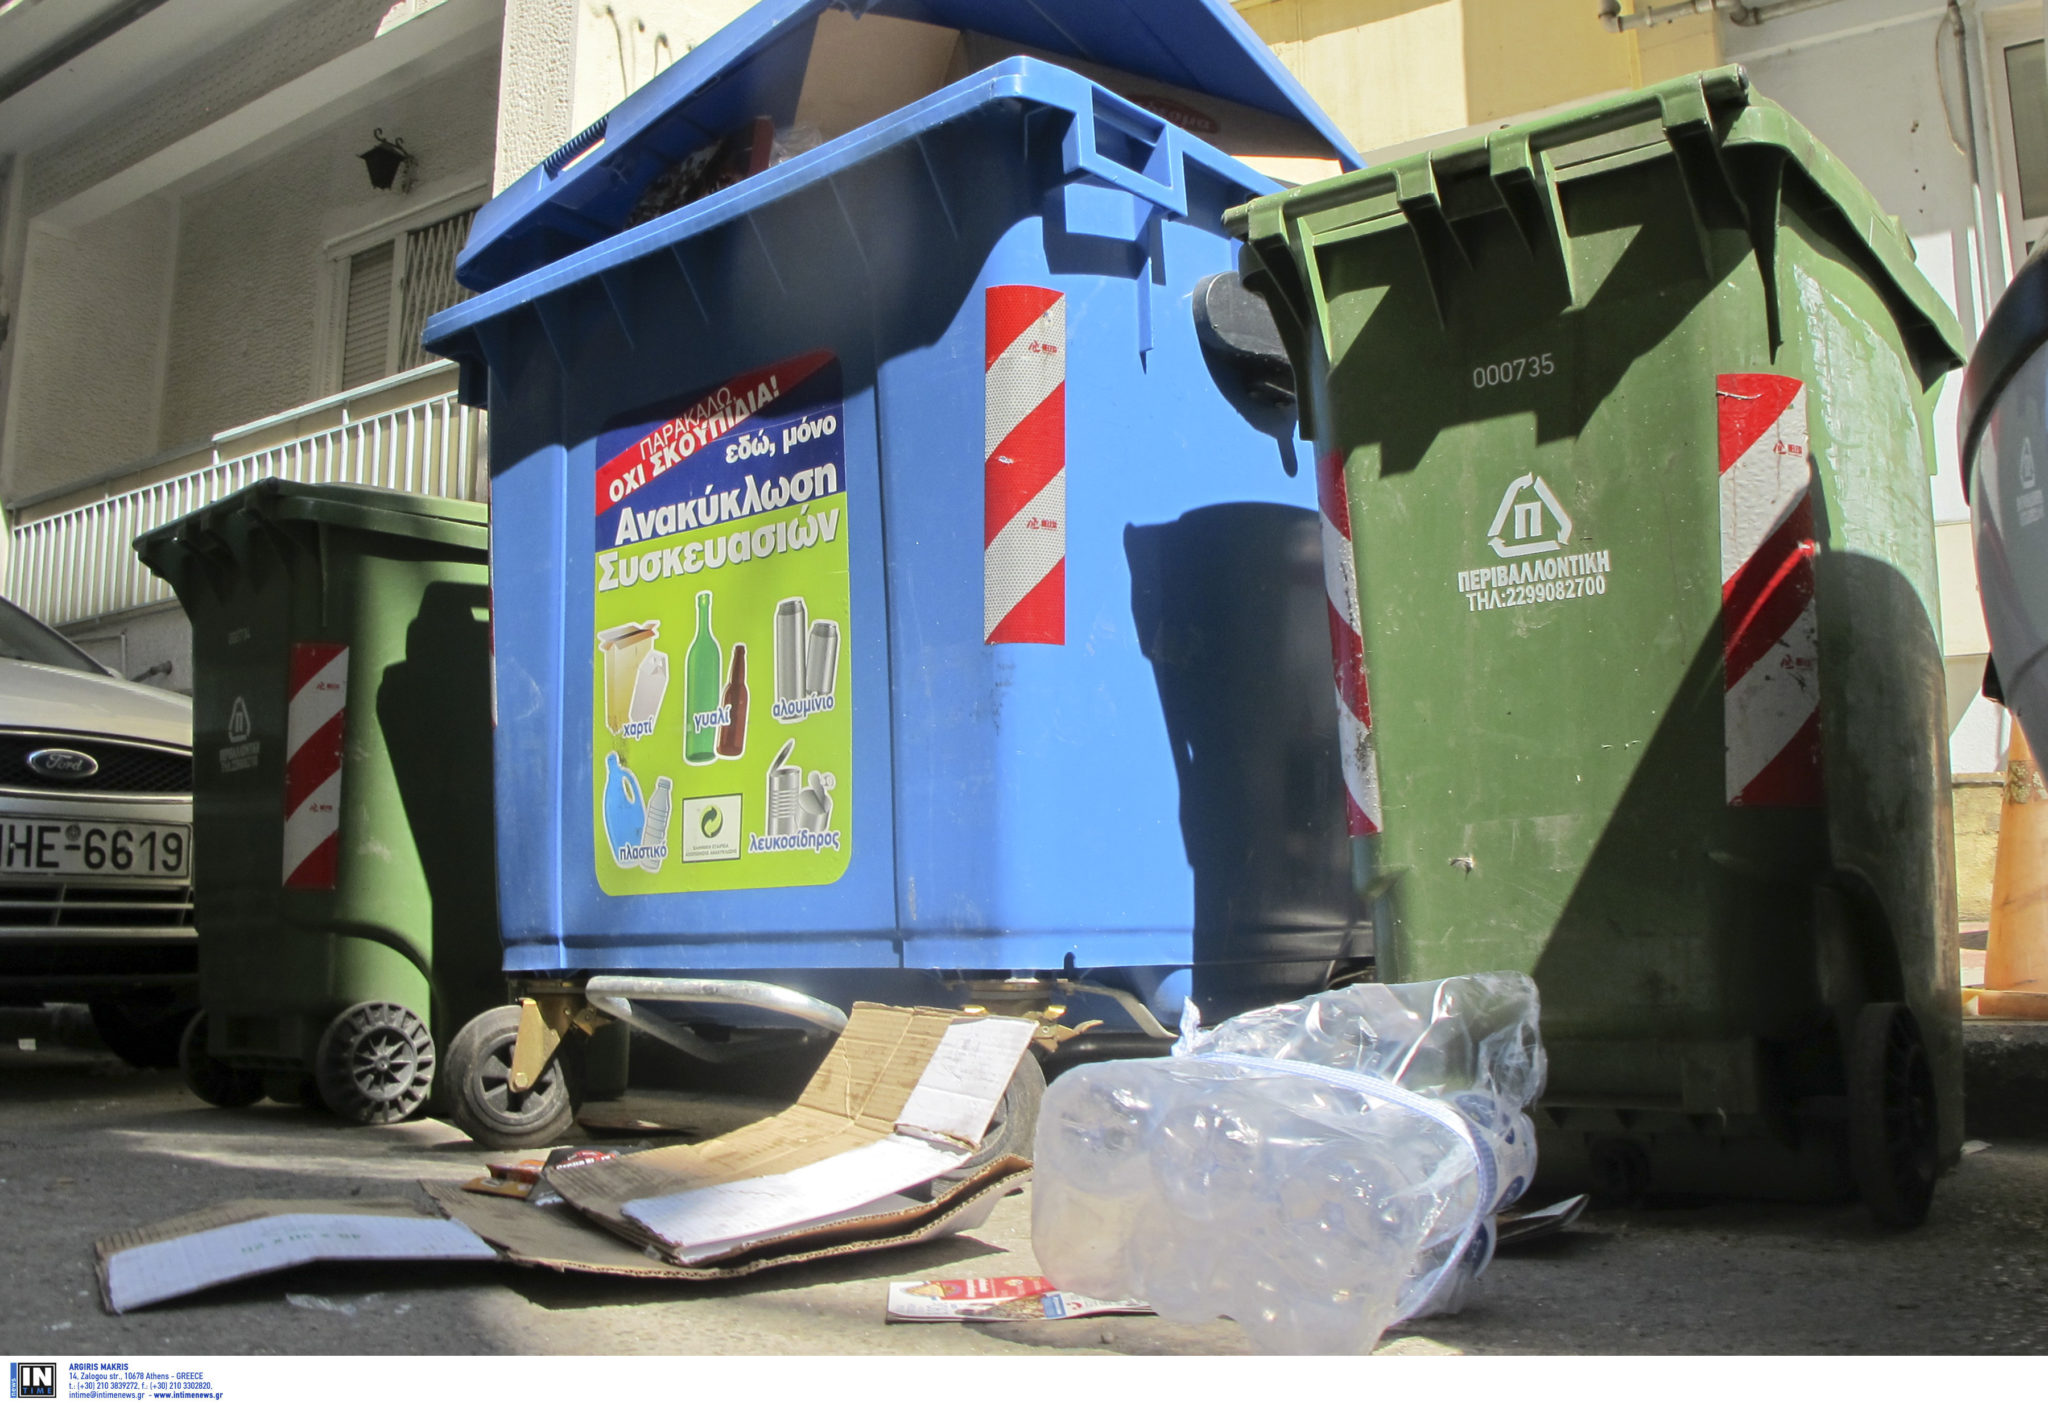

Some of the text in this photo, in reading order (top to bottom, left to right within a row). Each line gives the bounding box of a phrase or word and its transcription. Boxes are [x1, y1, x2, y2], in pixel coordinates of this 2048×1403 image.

[1473, 353, 1555, 388] 000735
[609, 375, 780, 502] ΟΧΙ ΣΚΟΥΠΙΔΙΑ!
[725, 415, 837, 464] εδώ, μόνο
[614, 462, 838, 546] Ανακύκλωση
[598, 504, 841, 592] Συσκευασιών
[1458, 550, 1611, 592] ΠΕΡΙΒΑΛΛΟΝΤΙΚΗ
[1465, 575, 1606, 612] ΤΗΛ:2299082700
[694, 707, 731, 732] γυαλί
[772, 695, 835, 718] αλουμίνιο
[623, 717, 654, 739] χαρτί
[46, 753, 84, 771] Ford
[0, 823, 183, 872] HE-6619
[619, 841, 667, 861] πλαστικό
[749, 830, 841, 852] λευκοσίδηρος
